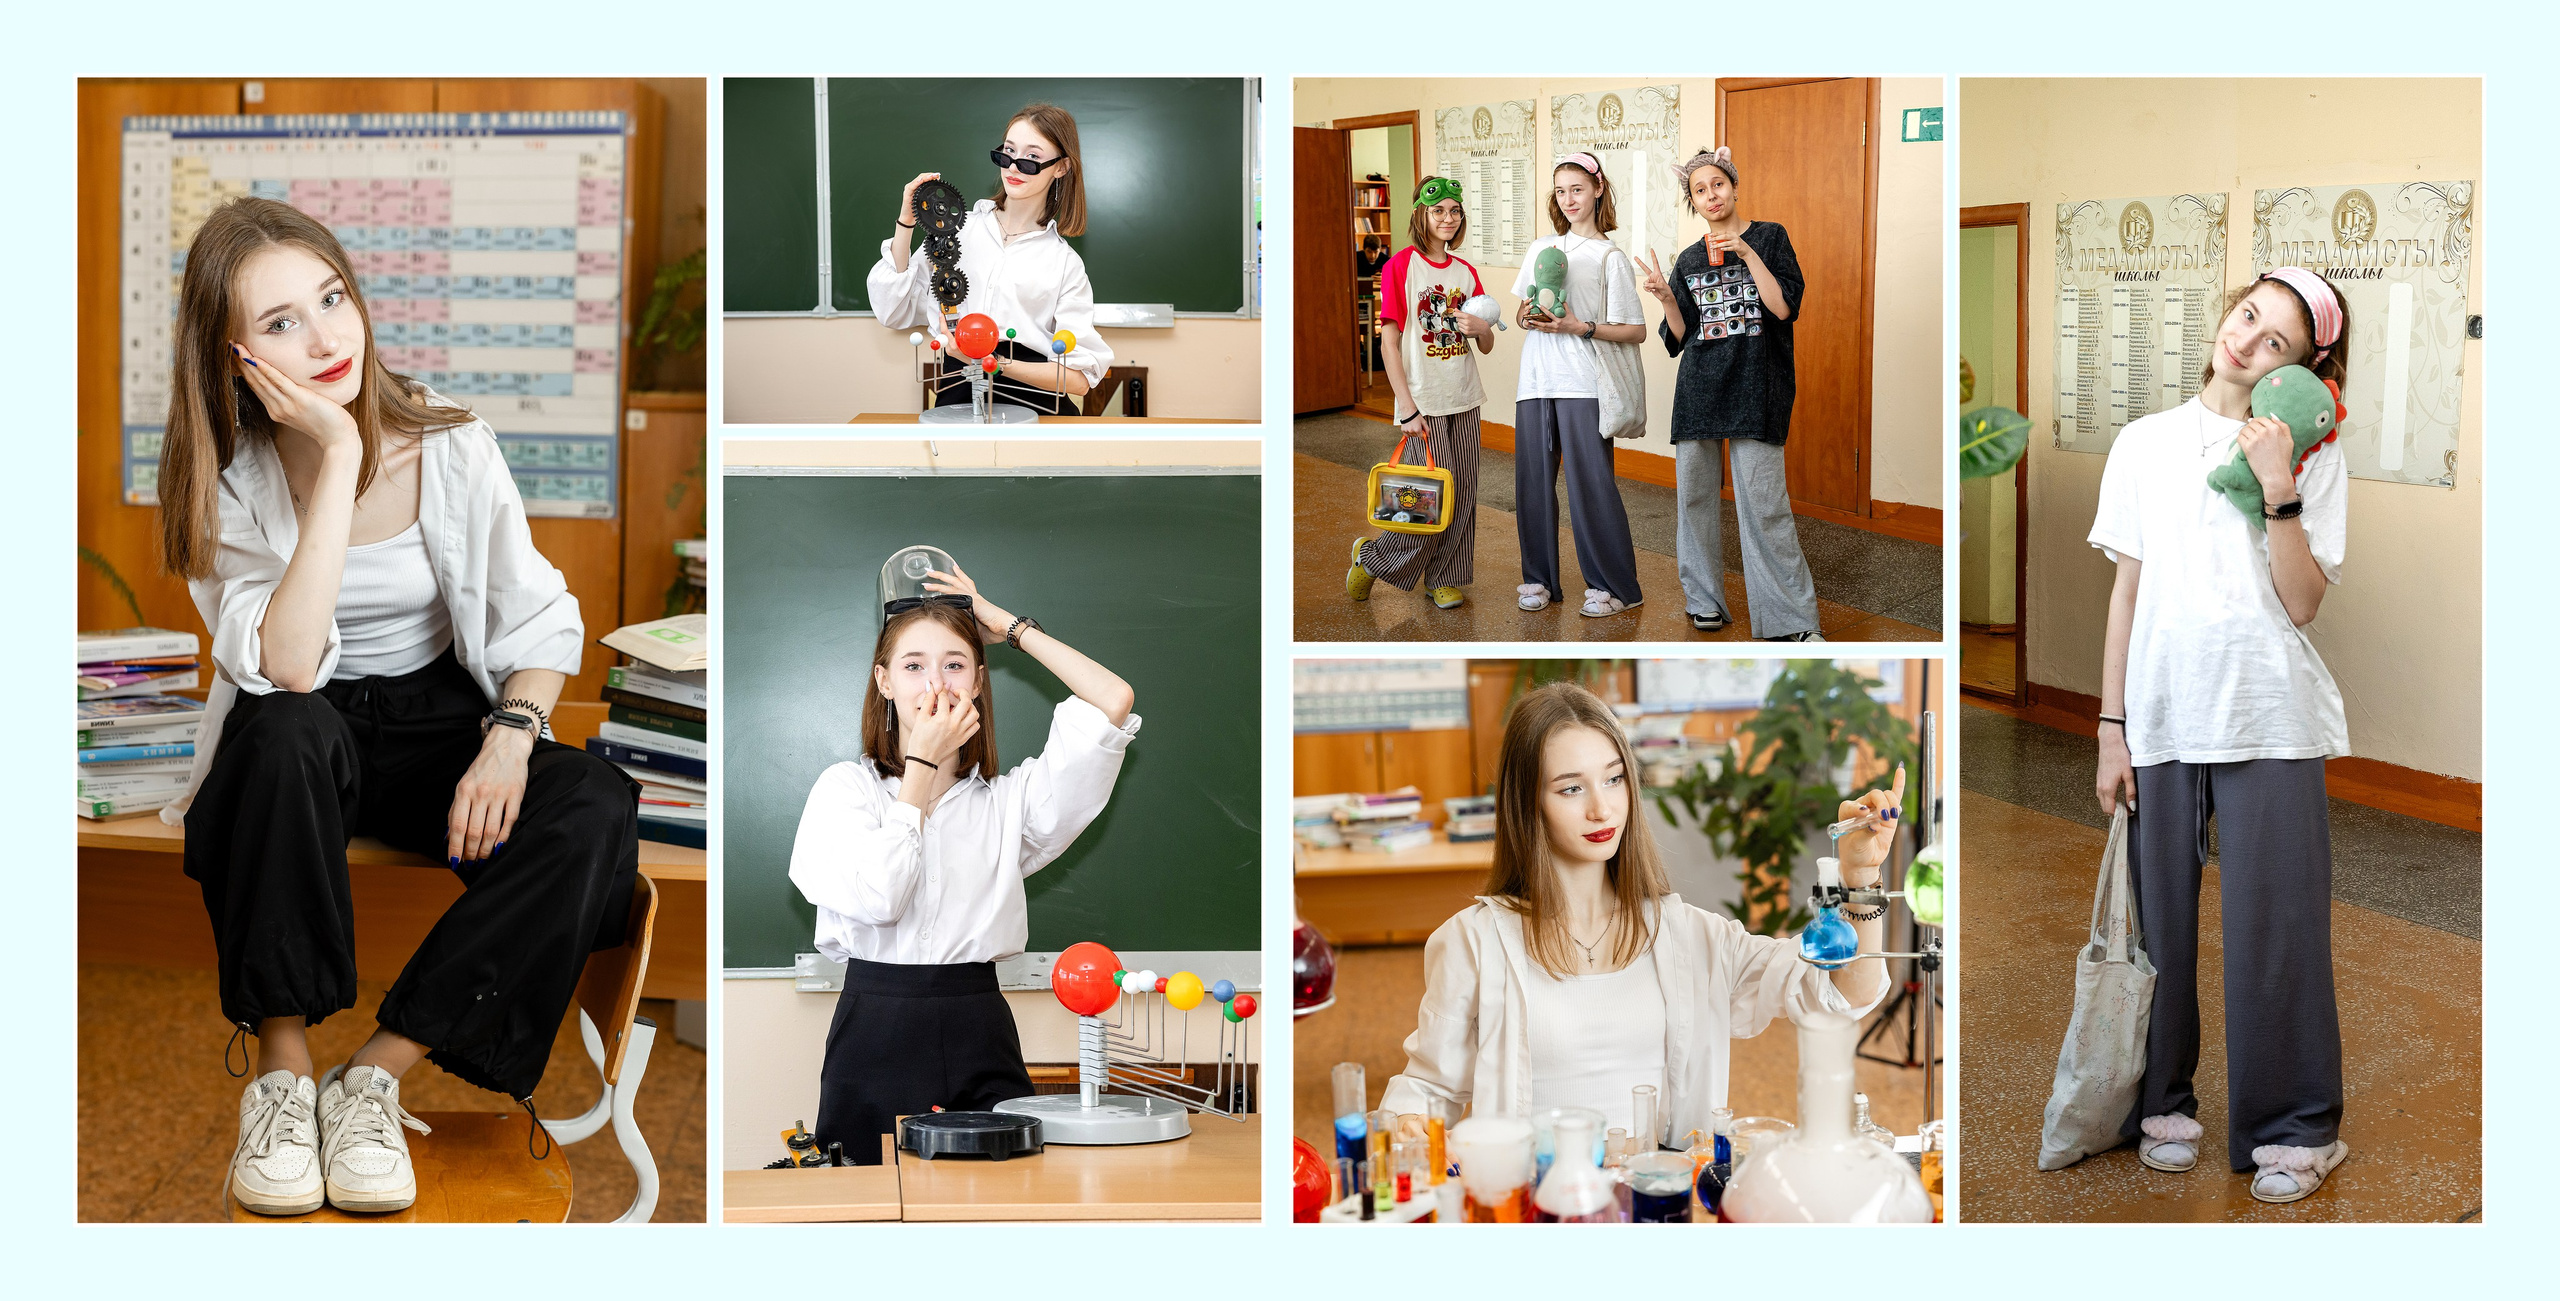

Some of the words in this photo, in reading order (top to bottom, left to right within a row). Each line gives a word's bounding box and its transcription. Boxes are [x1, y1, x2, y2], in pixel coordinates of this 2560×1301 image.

[1449, 132, 1521, 153] МЕДАЛИСТЫ
[1567, 122, 1659, 146] МЕДАЛИСТЫ
[1593, 142, 1629, 151] школы
[2079, 245, 2199, 275] МЕДАЛИСТЫ
[2280, 239, 2435, 272] МЕДАЛИСТЫ
[2114, 270, 2160, 282] школы
[2324, 267, 2384, 280] школы
